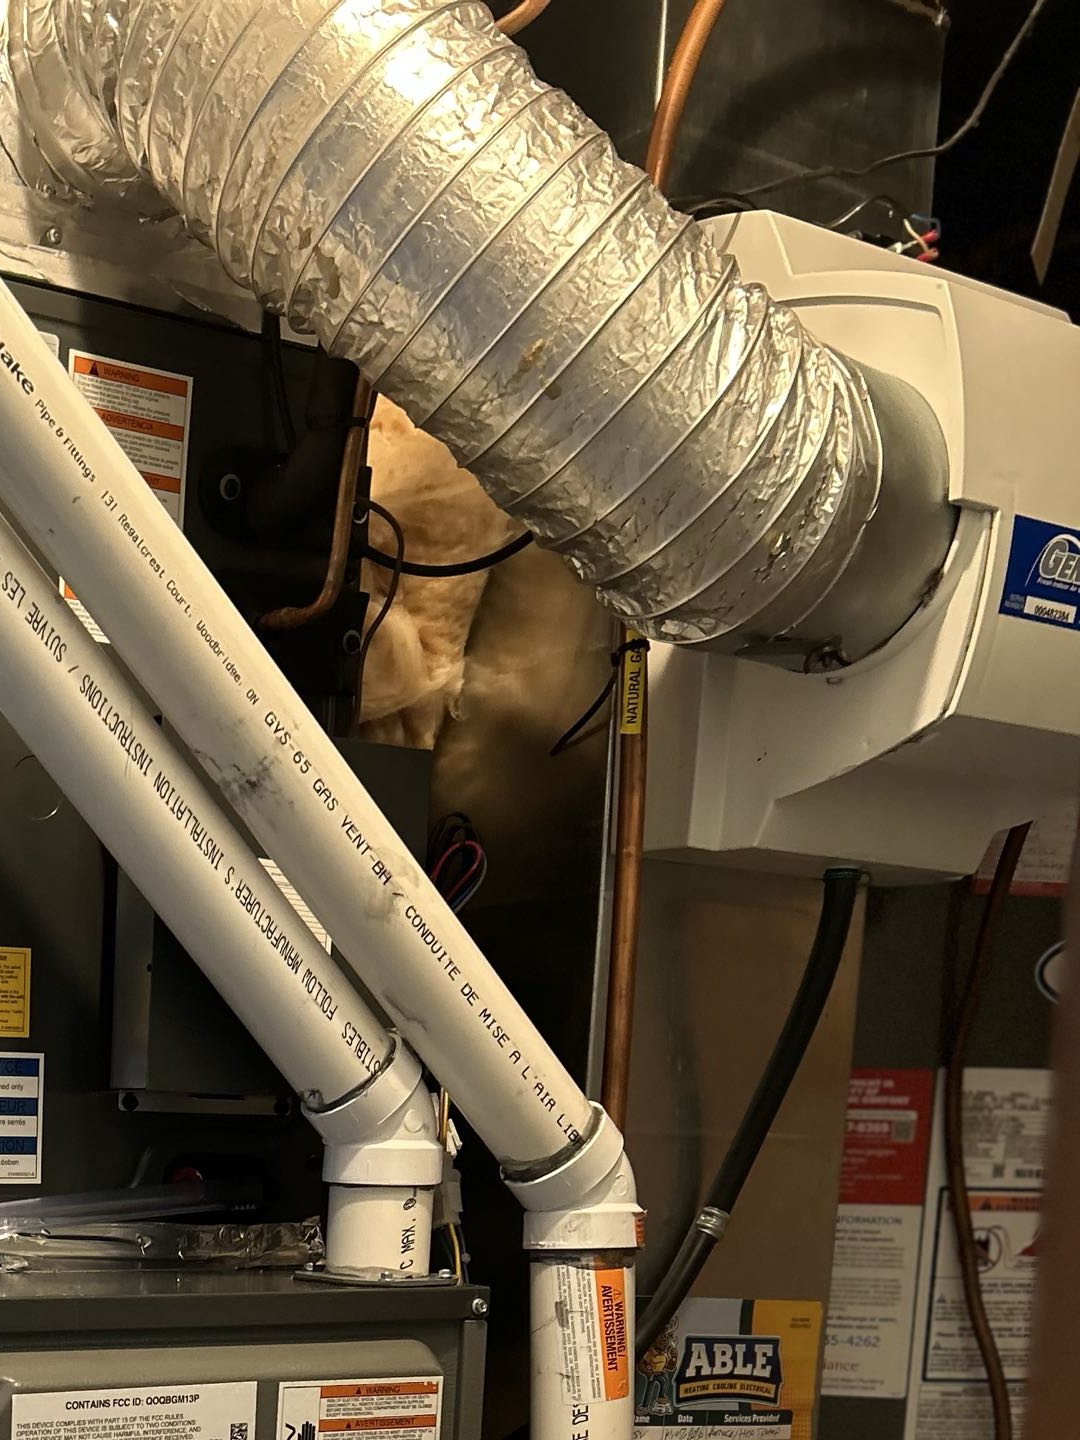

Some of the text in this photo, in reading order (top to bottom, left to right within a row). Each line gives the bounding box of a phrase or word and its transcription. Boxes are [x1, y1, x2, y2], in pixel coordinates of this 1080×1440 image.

[103, 366, 140, 382] WARNING
[34, 398, 98, 483] Pipe & Fittings
[2, 571, 27, 609] LES
[101, 490, 119, 512] 131
[118, 512, 166, 578] Regalcrest
[196, 620, 242, 686] Woodbridge,
[246, 688, 260, 706] ON
[24, 600, 68, 664] SUIVRE
[626, 668, 640, 724] NATURAL
[80, 674, 153, 777] INSTRUCTIONS
[153, 770, 225, 872] INSTALLATION
[264, 711, 312, 774] GVS-65
[313, 778, 339, 812] GAS
[340, 816, 392, 886] VENT-BH
[404, 905, 461, 982] CONDUITE
[460, 982, 480, 1006] DE
[478, 1008, 510, 1048] MISE
[224, 865, 302, 976] MANUFACTURER'S
[302, 968, 338, 1021] FOLLOW
[11, 1082, 24, 1092] only
[601, 1285, 618, 1372] AVERTISSEMENT
[685, 1343, 773, 1378] ABLE
[66, 1394, 200, 1410] CONTAINS FCC ID: QOQBGM13P
[365, 1385, 401, 1395] WARNING
[684, 1384, 709, 1394] HEATING
[354, 1417, 415, 1428] AVERTISSEMENT
[678, 1415, 693, 1423] Date
[724, 1414, 751, 1423] Services
